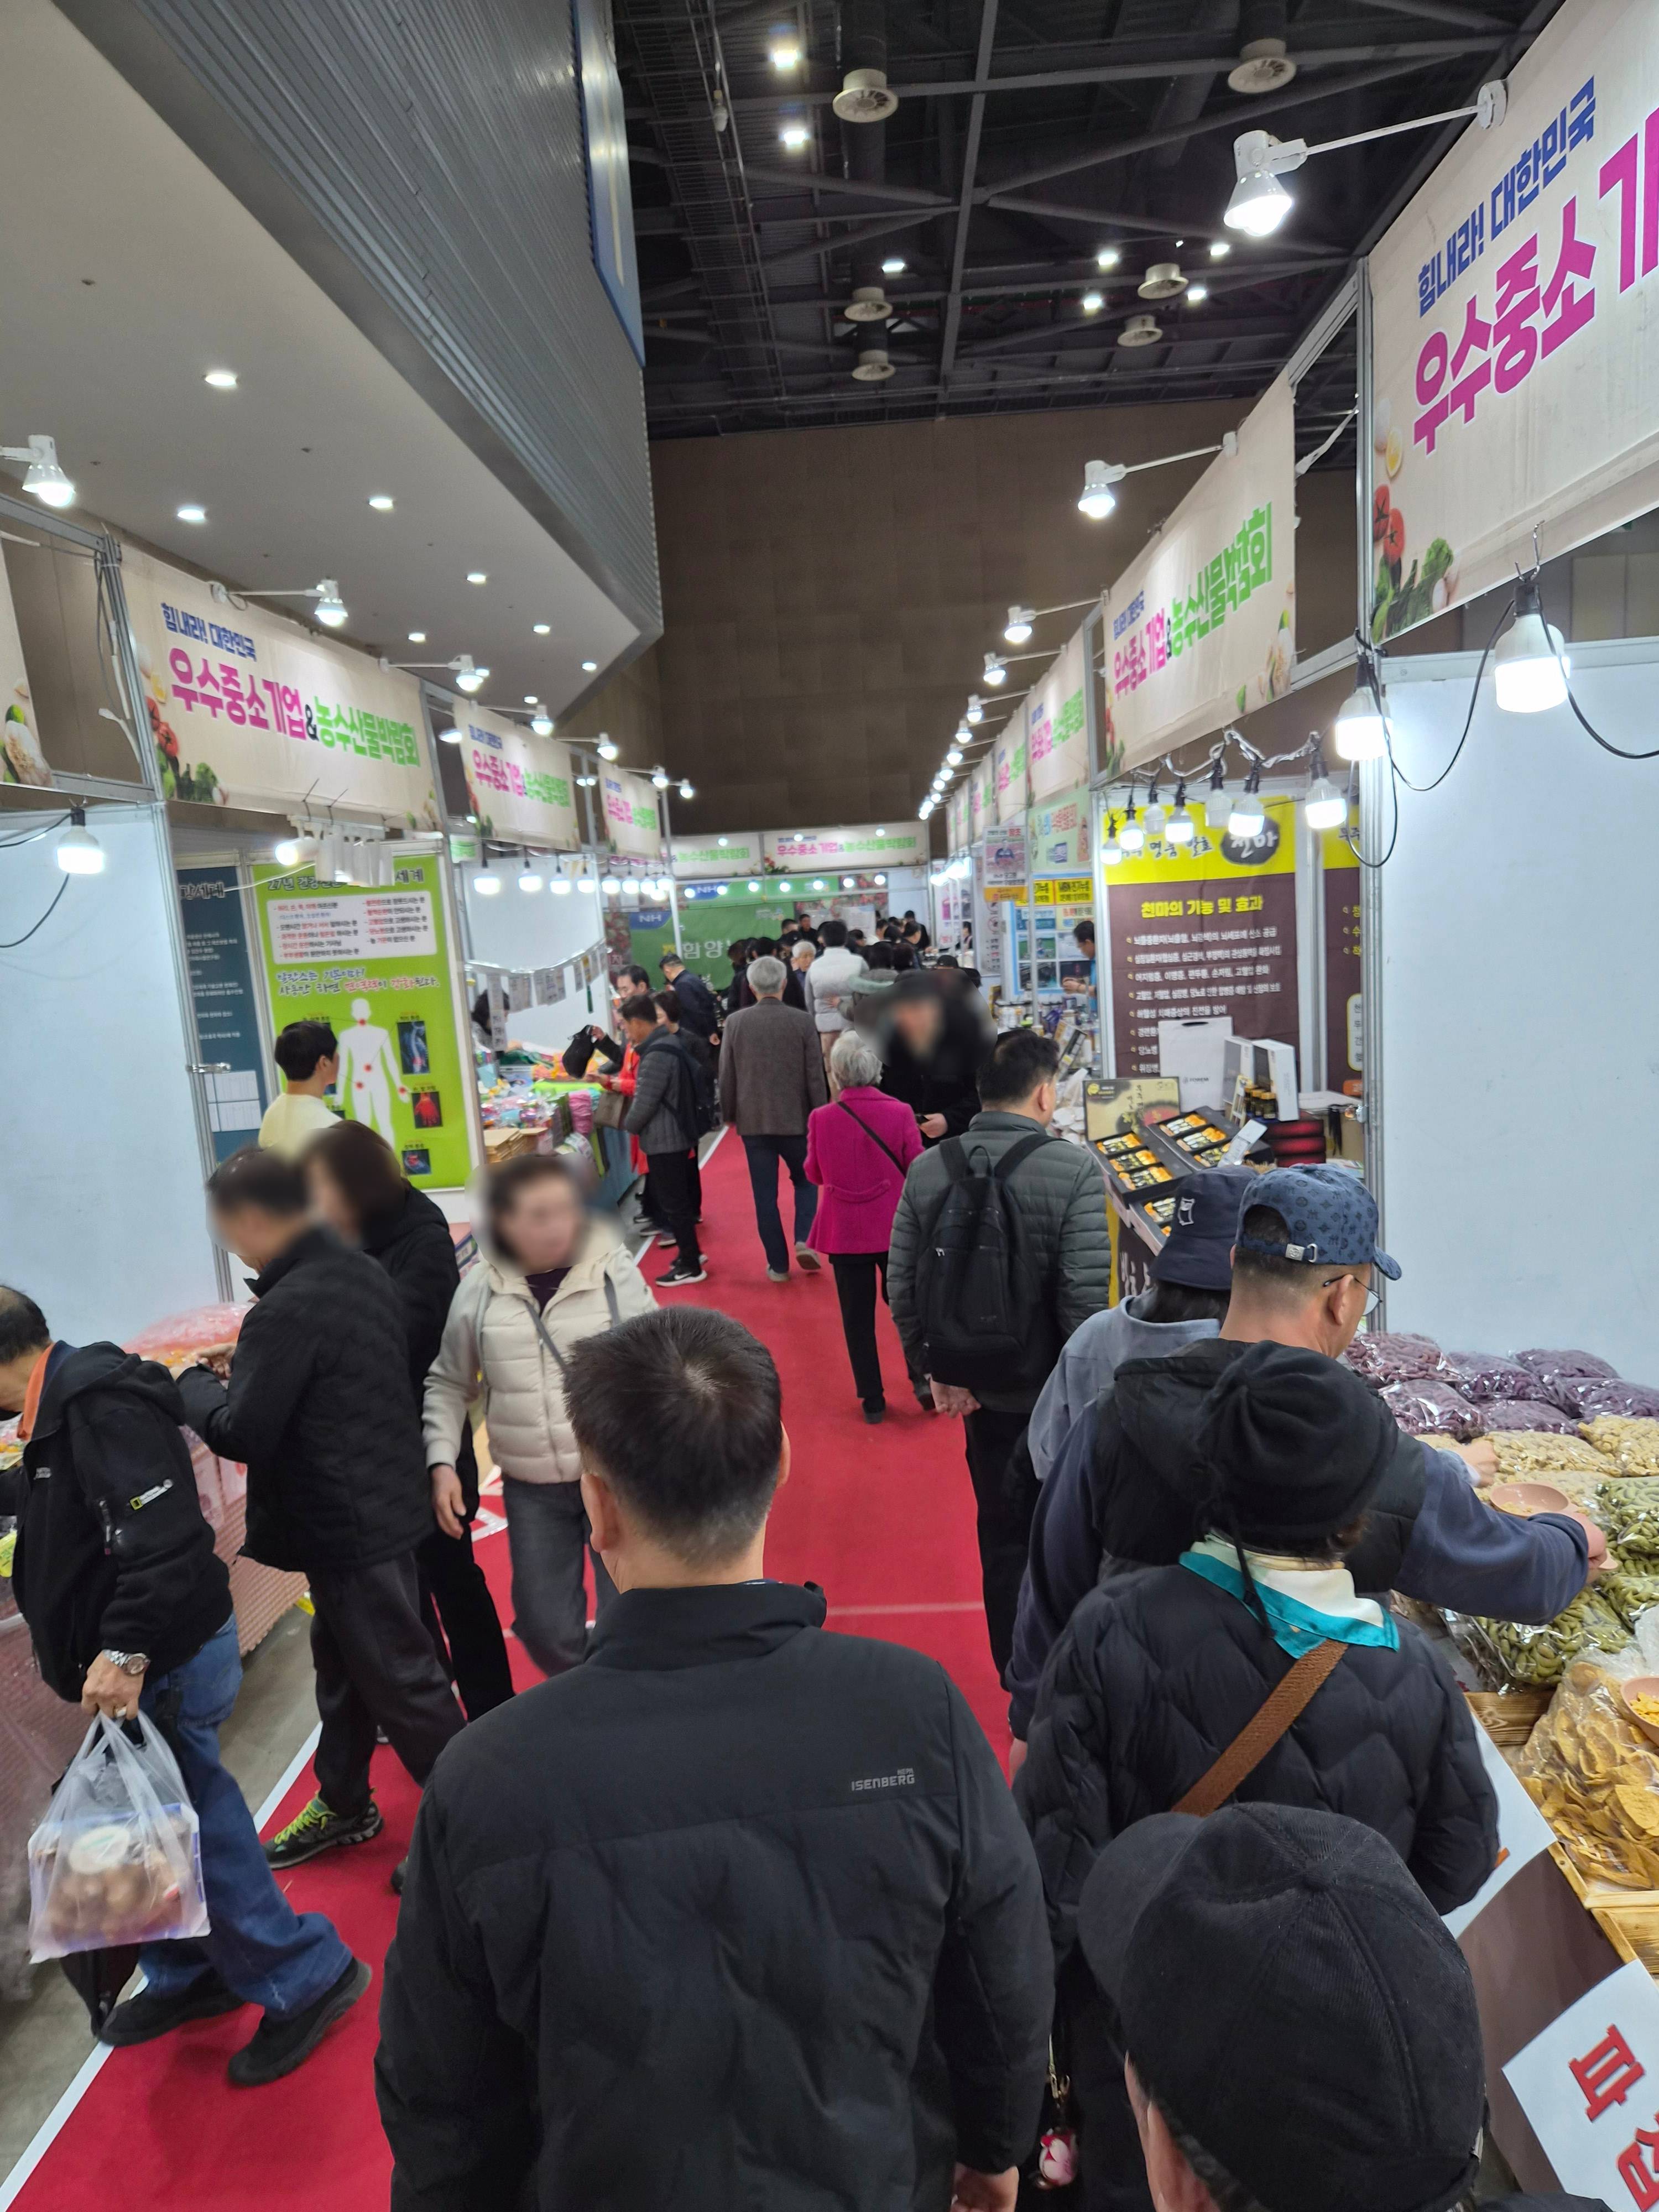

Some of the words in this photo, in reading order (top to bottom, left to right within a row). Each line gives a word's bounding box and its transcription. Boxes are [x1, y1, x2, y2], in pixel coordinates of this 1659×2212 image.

[1418, 201, 1485, 319] 힘내라!
[1490, 75, 1597, 242] 대한민국
[161, 602, 208, 644] 힘내라!
[208, 623, 257, 662] 대한민국
[1141, 901, 1183, 918] 천마의
[1187, 899, 1214, 915] 기능
[1218, 898, 1232, 914] 및
[1235, 895, 1263, 912] 효과
[639, 914, 662, 923] NH
[682, 940, 731, 960] 함양
